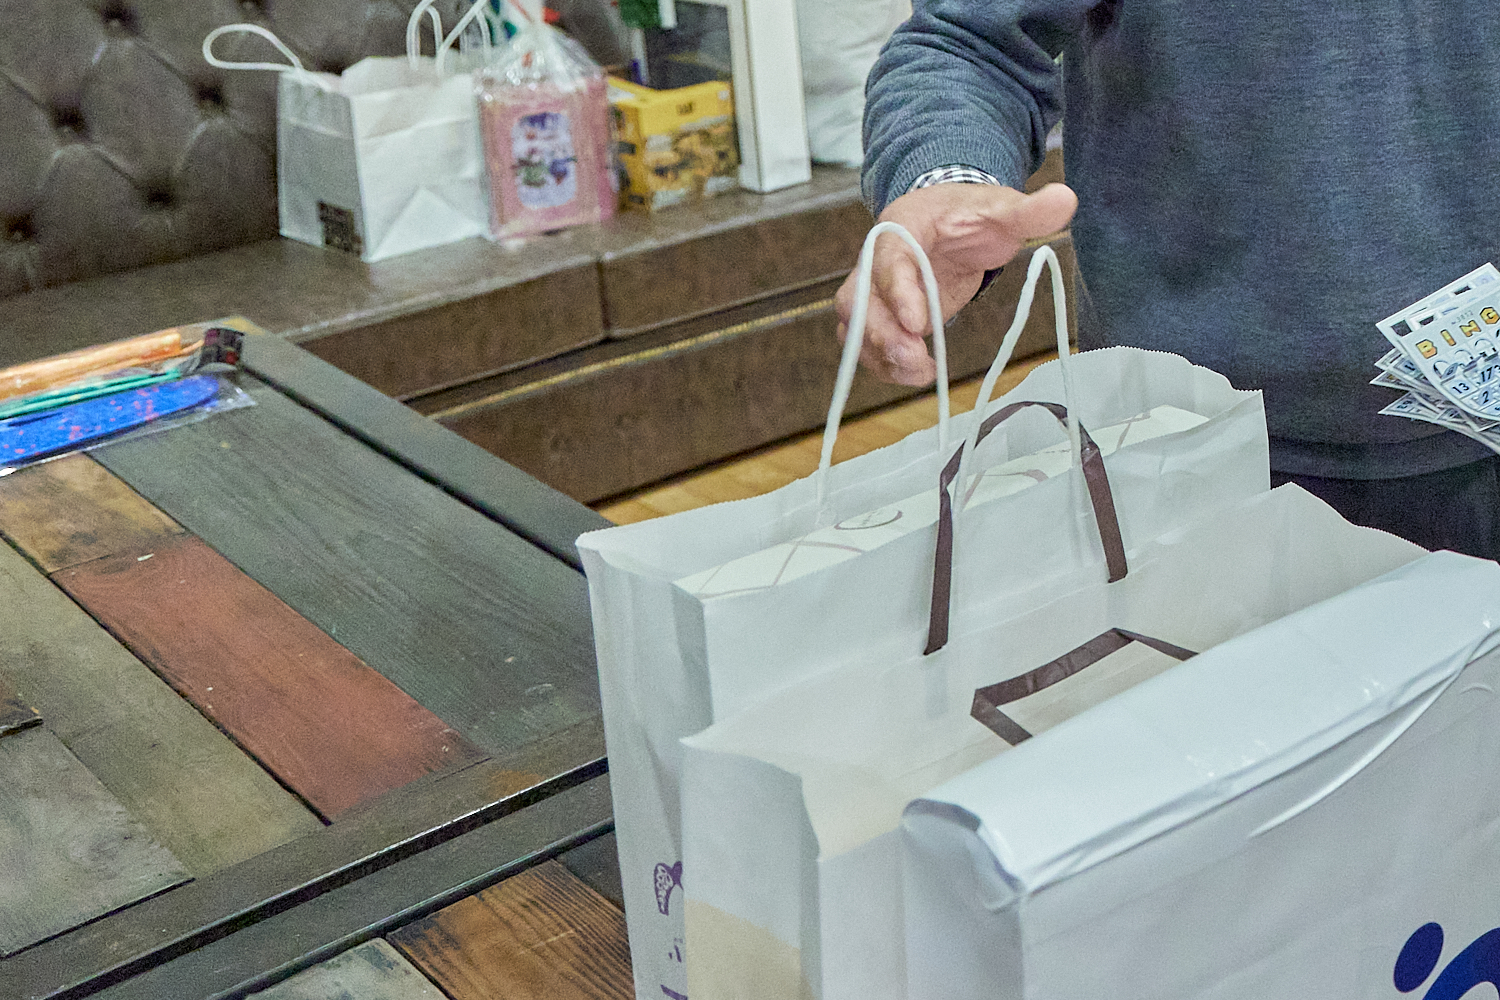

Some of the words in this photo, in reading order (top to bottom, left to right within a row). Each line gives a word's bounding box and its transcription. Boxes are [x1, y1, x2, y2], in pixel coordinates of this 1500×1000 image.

[1481, 366, 1493, 382] 17
[1452, 382, 1470, 394] 13
[1482, 391, 1490, 404] 2
